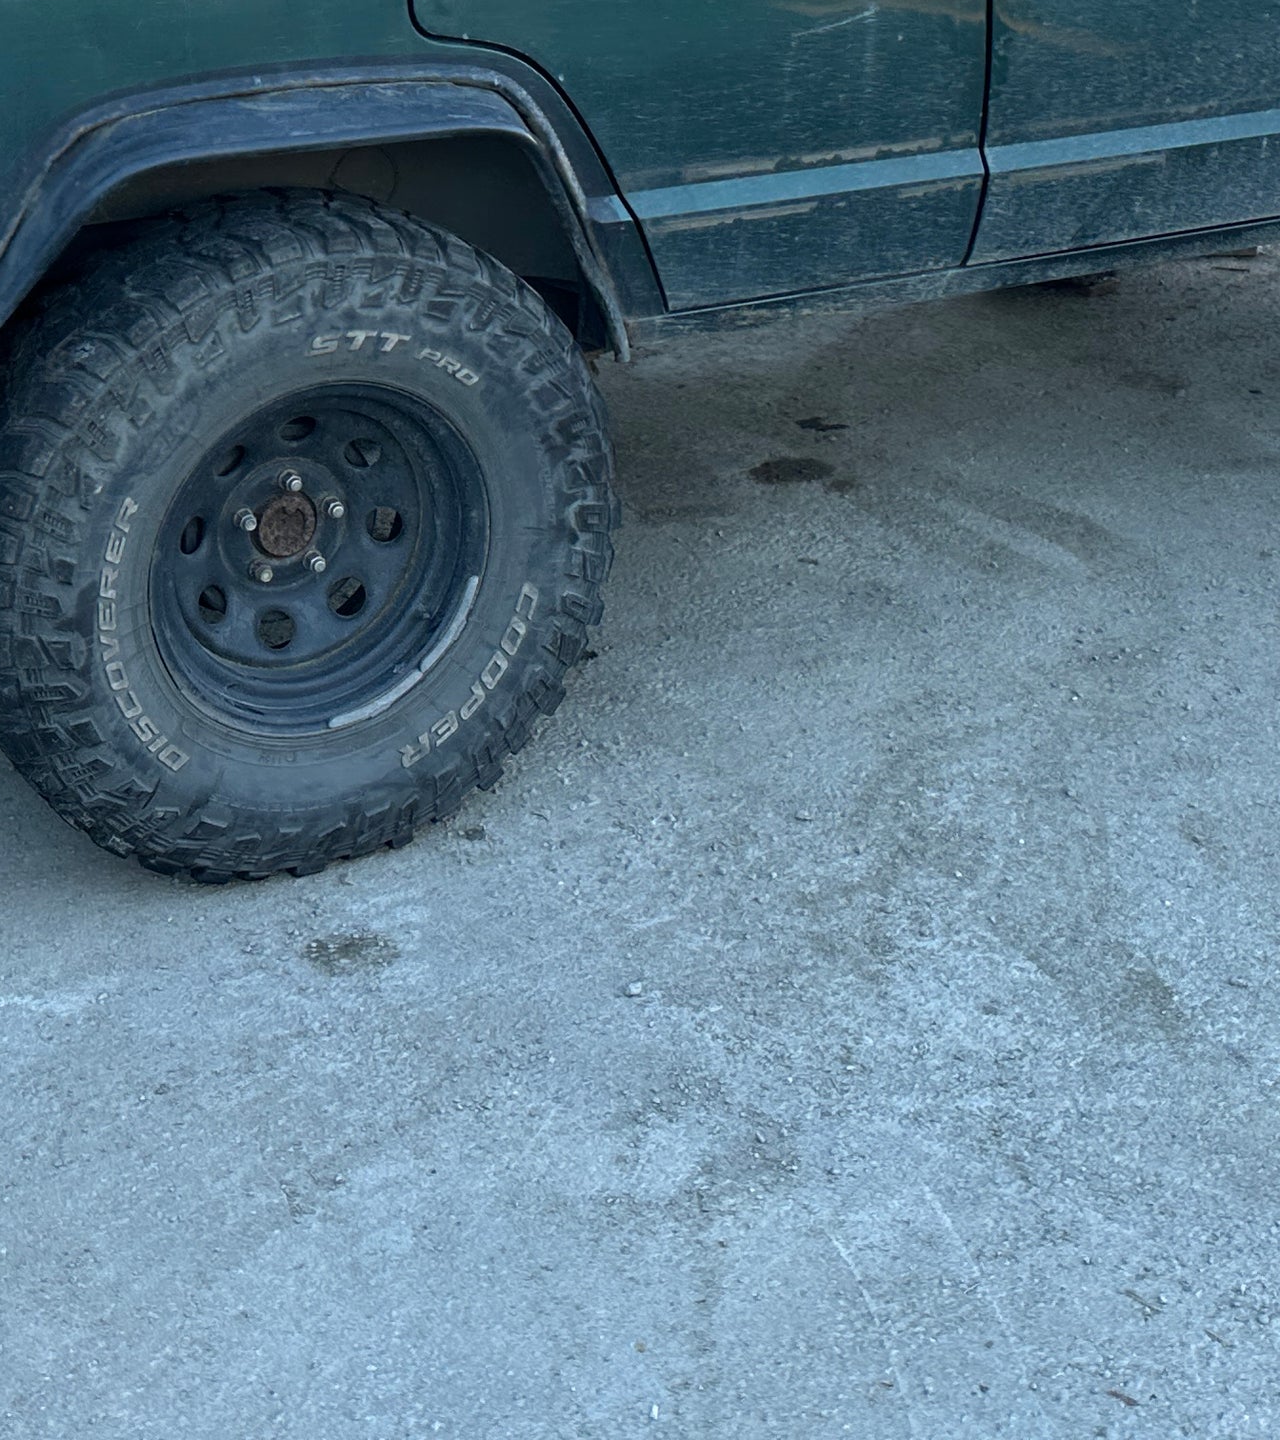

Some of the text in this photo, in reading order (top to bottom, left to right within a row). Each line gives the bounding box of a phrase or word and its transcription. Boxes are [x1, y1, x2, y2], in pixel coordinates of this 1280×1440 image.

[305, 329, 480, 387] STT PRO
[97, 496, 191, 772] DISCOVERER
[398, 582, 539, 768] COOPER
